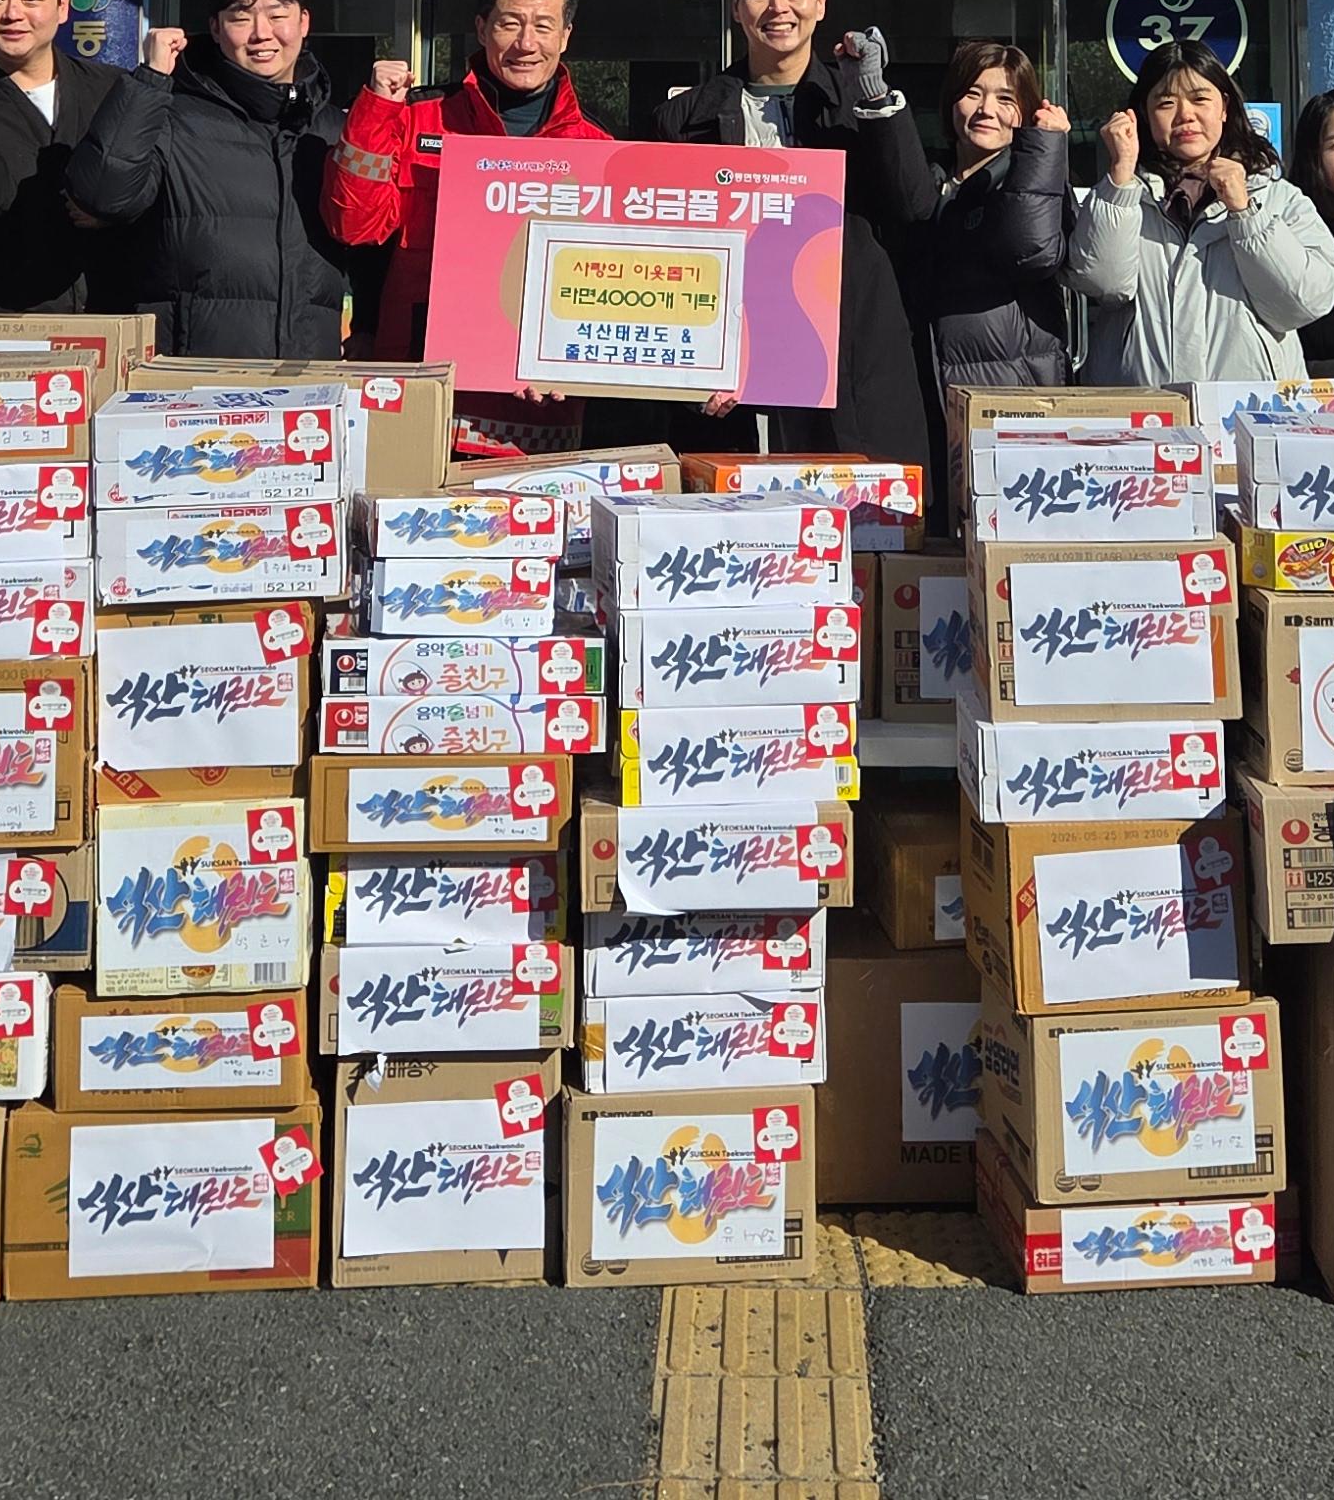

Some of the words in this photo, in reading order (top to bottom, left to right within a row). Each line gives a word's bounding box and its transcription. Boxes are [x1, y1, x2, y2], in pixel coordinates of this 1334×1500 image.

[1138, 14, 1215, 51] 37
[485, 180, 612, 218] 이웃돕기
[622, 186, 719, 223] 성금품
[728, 191, 796, 226] 기탁
[573, 260, 624, 280] 사랑의
[634, 263, 701, 283] 이웃돕기
[560, 286, 674, 311] 라면4000개
[687, 292, 717, 311] 기탁
[576, 322, 669, 343] 석산태권도
[681, 327, 692, 344] &
[565, 342, 696, 366] 줄친구점프점프
[264, 487, 281, 498] 52
[287, 486, 310, 497] 121
[1299, 538, 1327, 553] BIG
[267, 582, 284, 593] 52
[291, 581, 313, 592] 121
[436, 663, 510, 693] 줄친구
[437, 726, 511, 754] 줄친구
[900, 1146, 962, 1165] MADE
